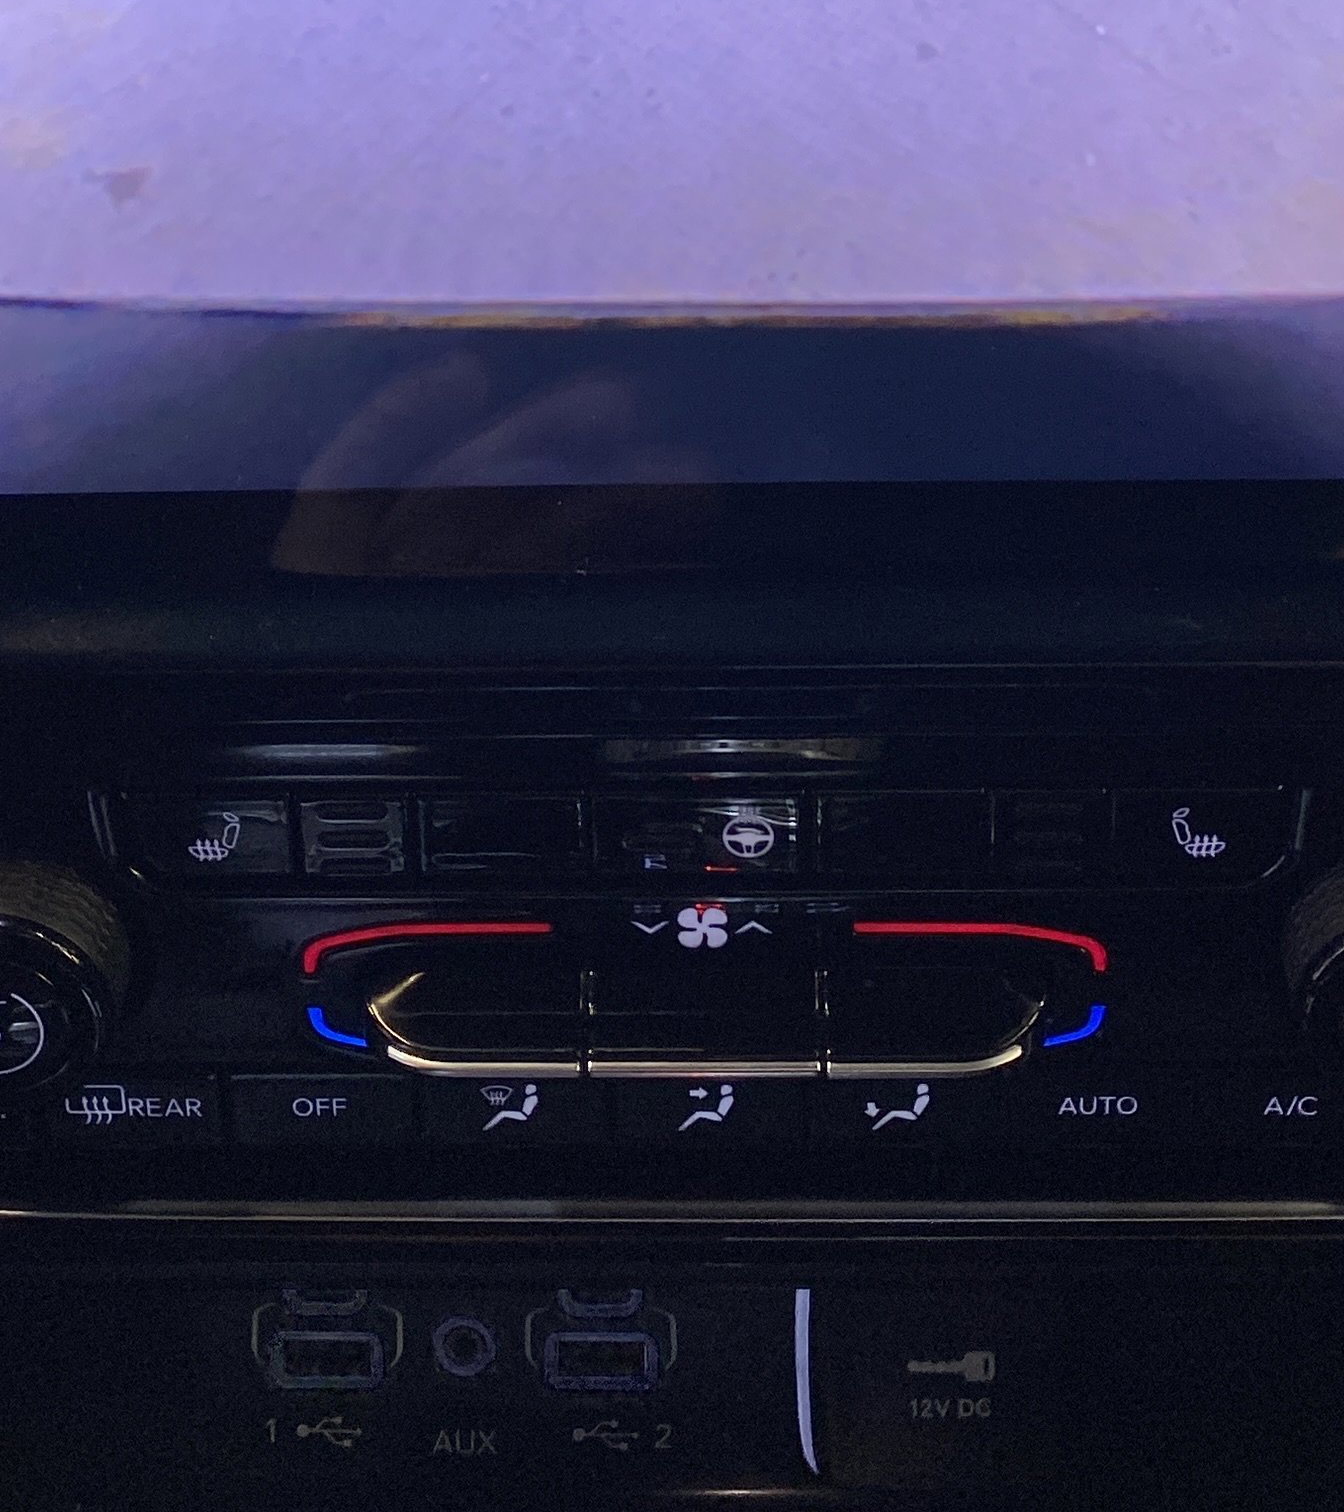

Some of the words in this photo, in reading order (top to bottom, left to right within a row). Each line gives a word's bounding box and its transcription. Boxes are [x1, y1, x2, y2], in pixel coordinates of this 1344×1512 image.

[128, 1097, 202, 1117] REAR
[292, 1097, 347, 1118] OFF
[1058, 1096, 1139, 1117] AUTO
[1264, 1096, 1318, 1118] A/C
[907, 1398, 949, 1418] 12V
[958, 1398, 992, 1419] DC
[265, 1418, 277, 1443] 1
[655, 1424, 673, 1449] 2
[433, 1429, 498, 1455] AUX
